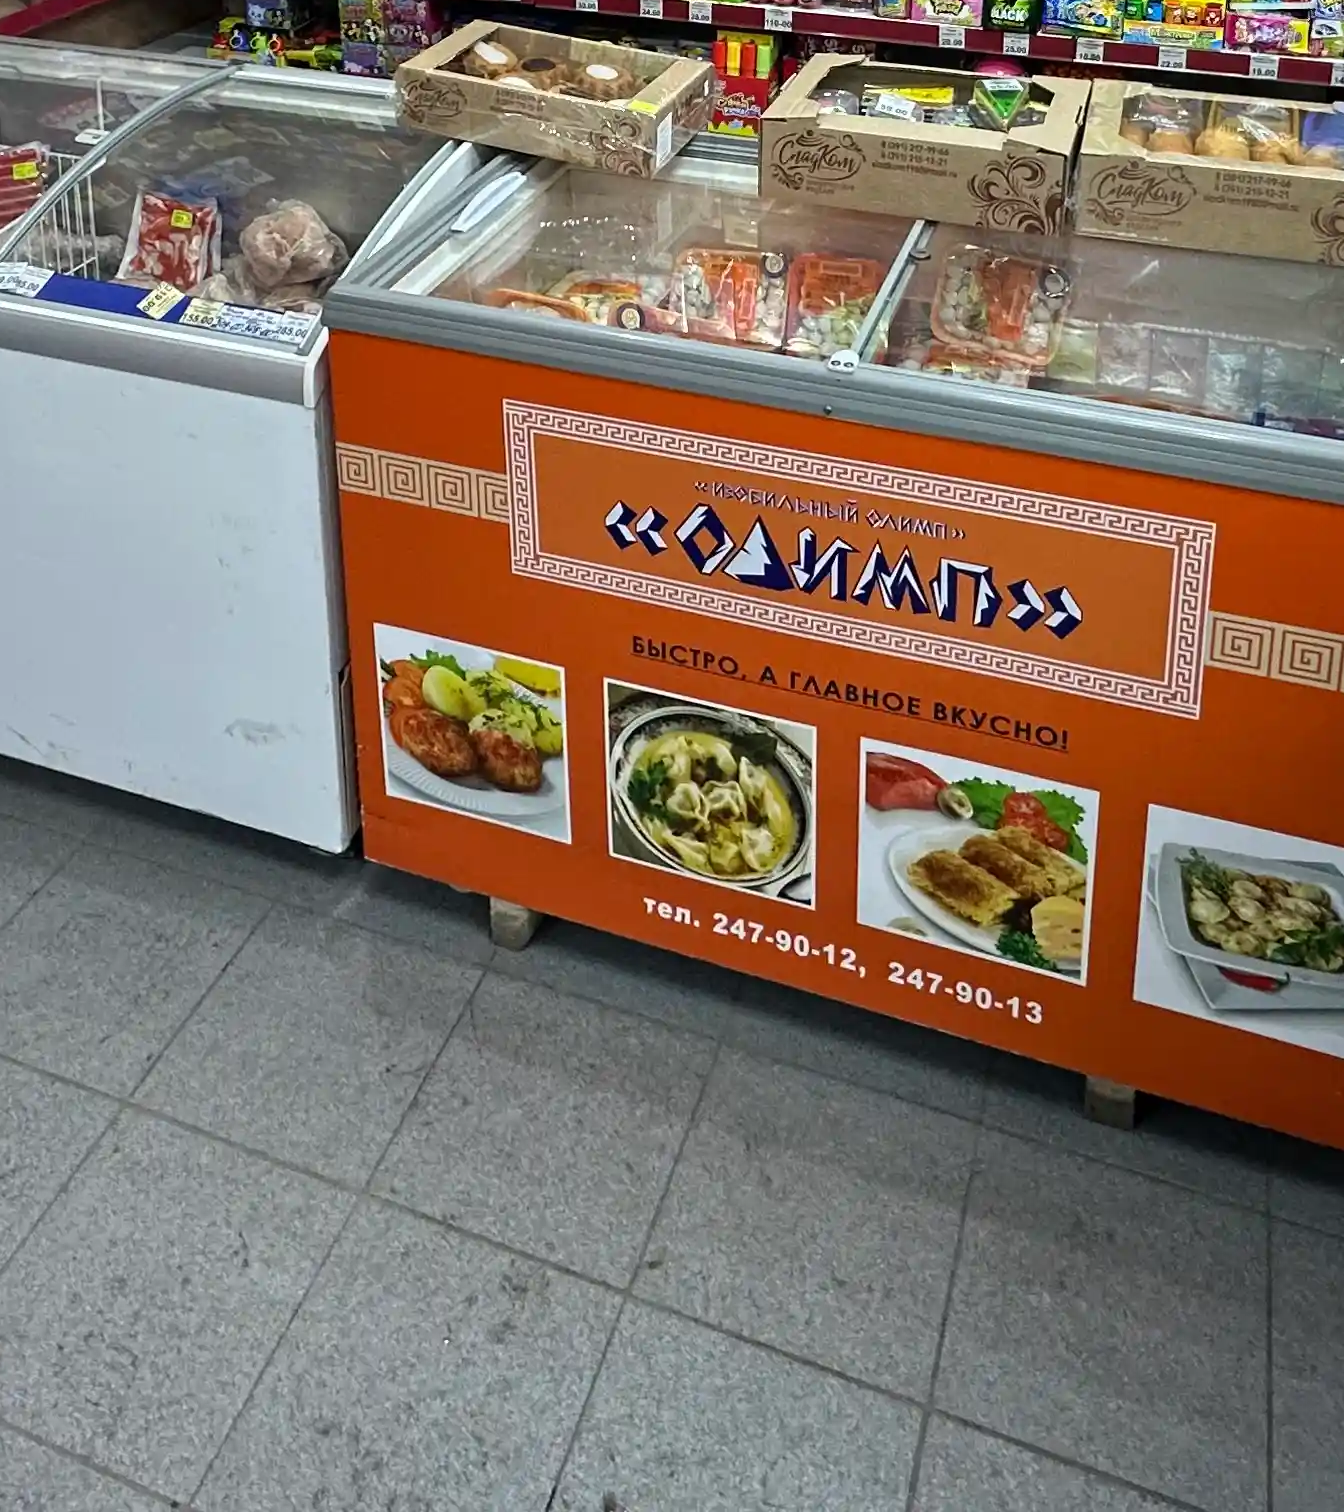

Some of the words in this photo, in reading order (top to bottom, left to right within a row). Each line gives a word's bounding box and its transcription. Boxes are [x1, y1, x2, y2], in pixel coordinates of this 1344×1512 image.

[631, 635, 750, 681] БЫСТРО,
[759, 665, 777, 686] А
[789, 670, 922, 717] ГЛАВНОЕ
[933, 702, 1070, 751] ВКУСНО!
[643, 897, 701, 928] тел.
[712, 912, 866, 978] 247-90-12,
[887, 961, 1044, 1025] 247-90-13
